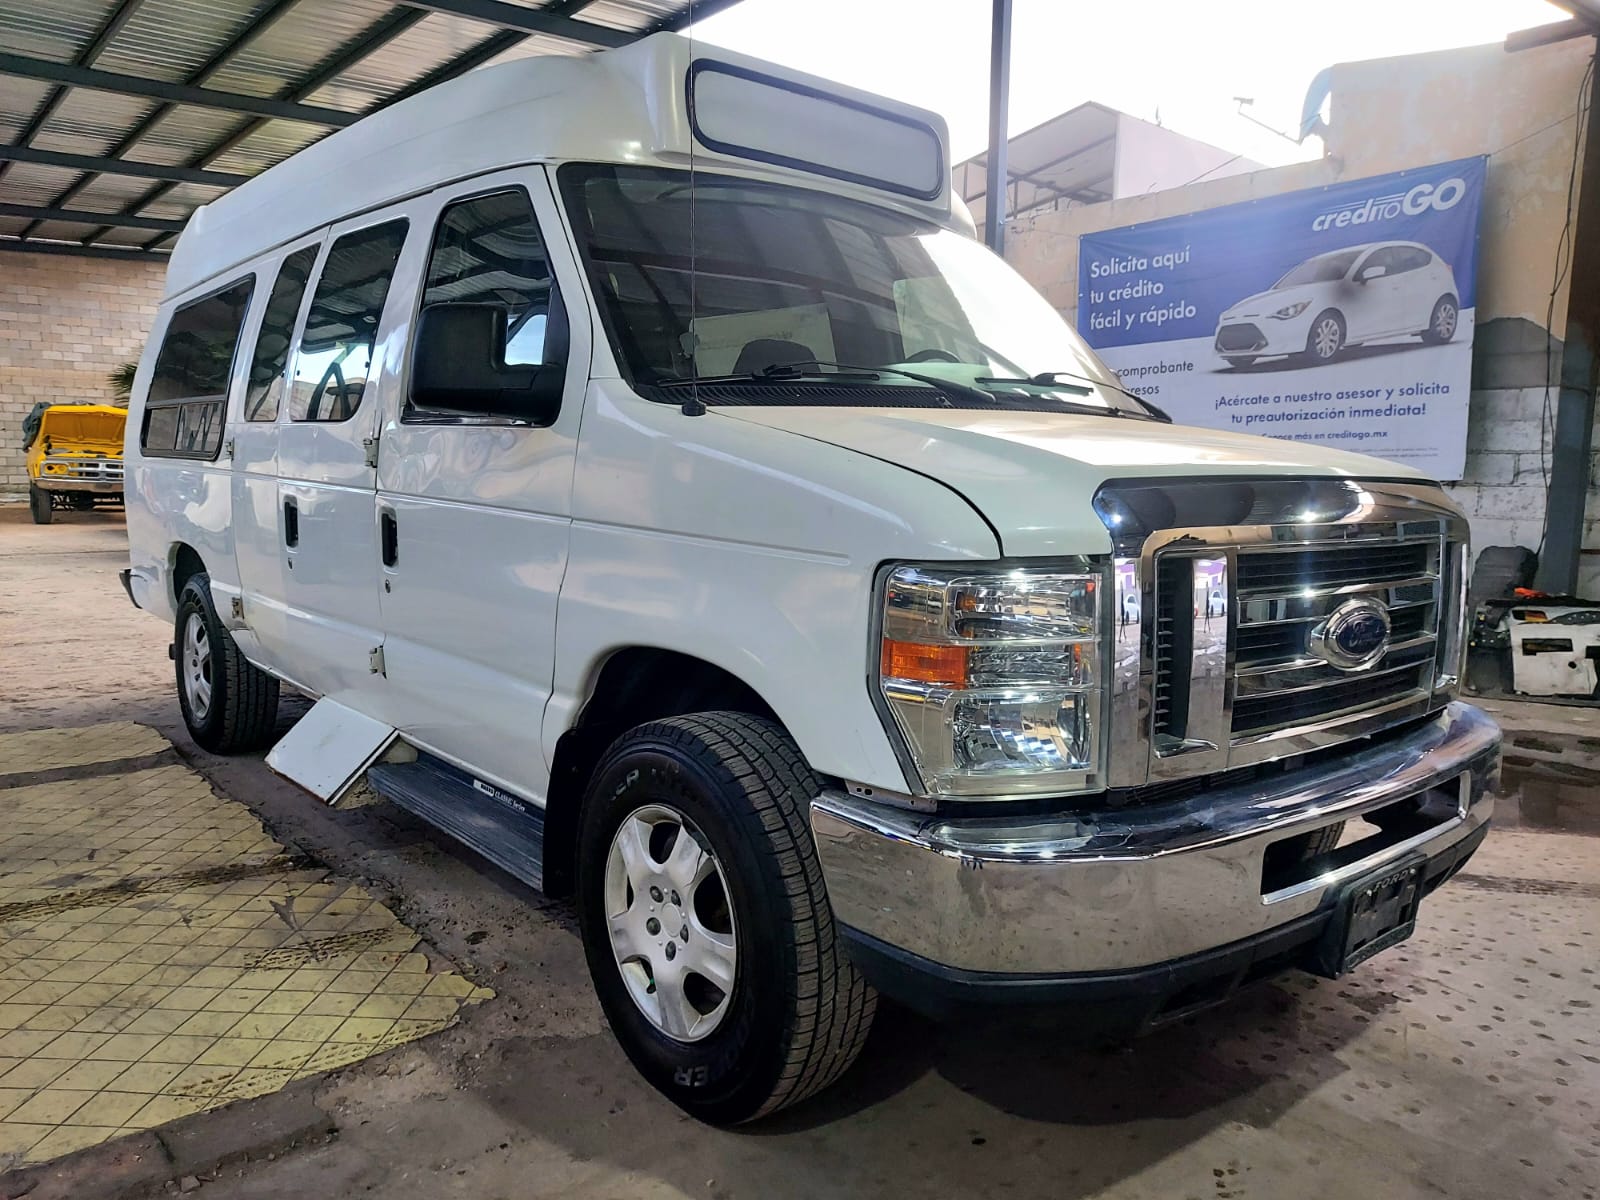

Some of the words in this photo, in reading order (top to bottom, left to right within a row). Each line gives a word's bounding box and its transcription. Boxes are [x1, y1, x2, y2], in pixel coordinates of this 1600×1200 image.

[1090, 256, 1147, 278] Solicita
[1152, 245, 1190, 270] aquí
[1090, 290, 1104, 304] tu
[1108, 279, 1164, 302] crédito
[1090, 309, 1121, 330] fácil
[1125, 313, 1135, 330] y
[1140, 300, 1197, 326] rápido
[1117, 360, 1194, 379] comprobante
[1215, 395, 1270, 410] ¡Acércate
[1273, 395, 1280, 404] a
[1284, 391, 1332, 403] nuestro
[1336, 389, 1382, 400] asesor
[1385, 388, 1394, 401] y
[1399, 382, 1450, 397] solicita
[1232, 414, 1243, 424] tu
[1245, 408, 1345, 426] preautorización
[1349, 403, 1426, 418] inmediata!
[1294, 431, 1312, 440] más
[1327, 430, 1388, 440] creditogo.mx
[1373, 870, 1409, 892] FORD
